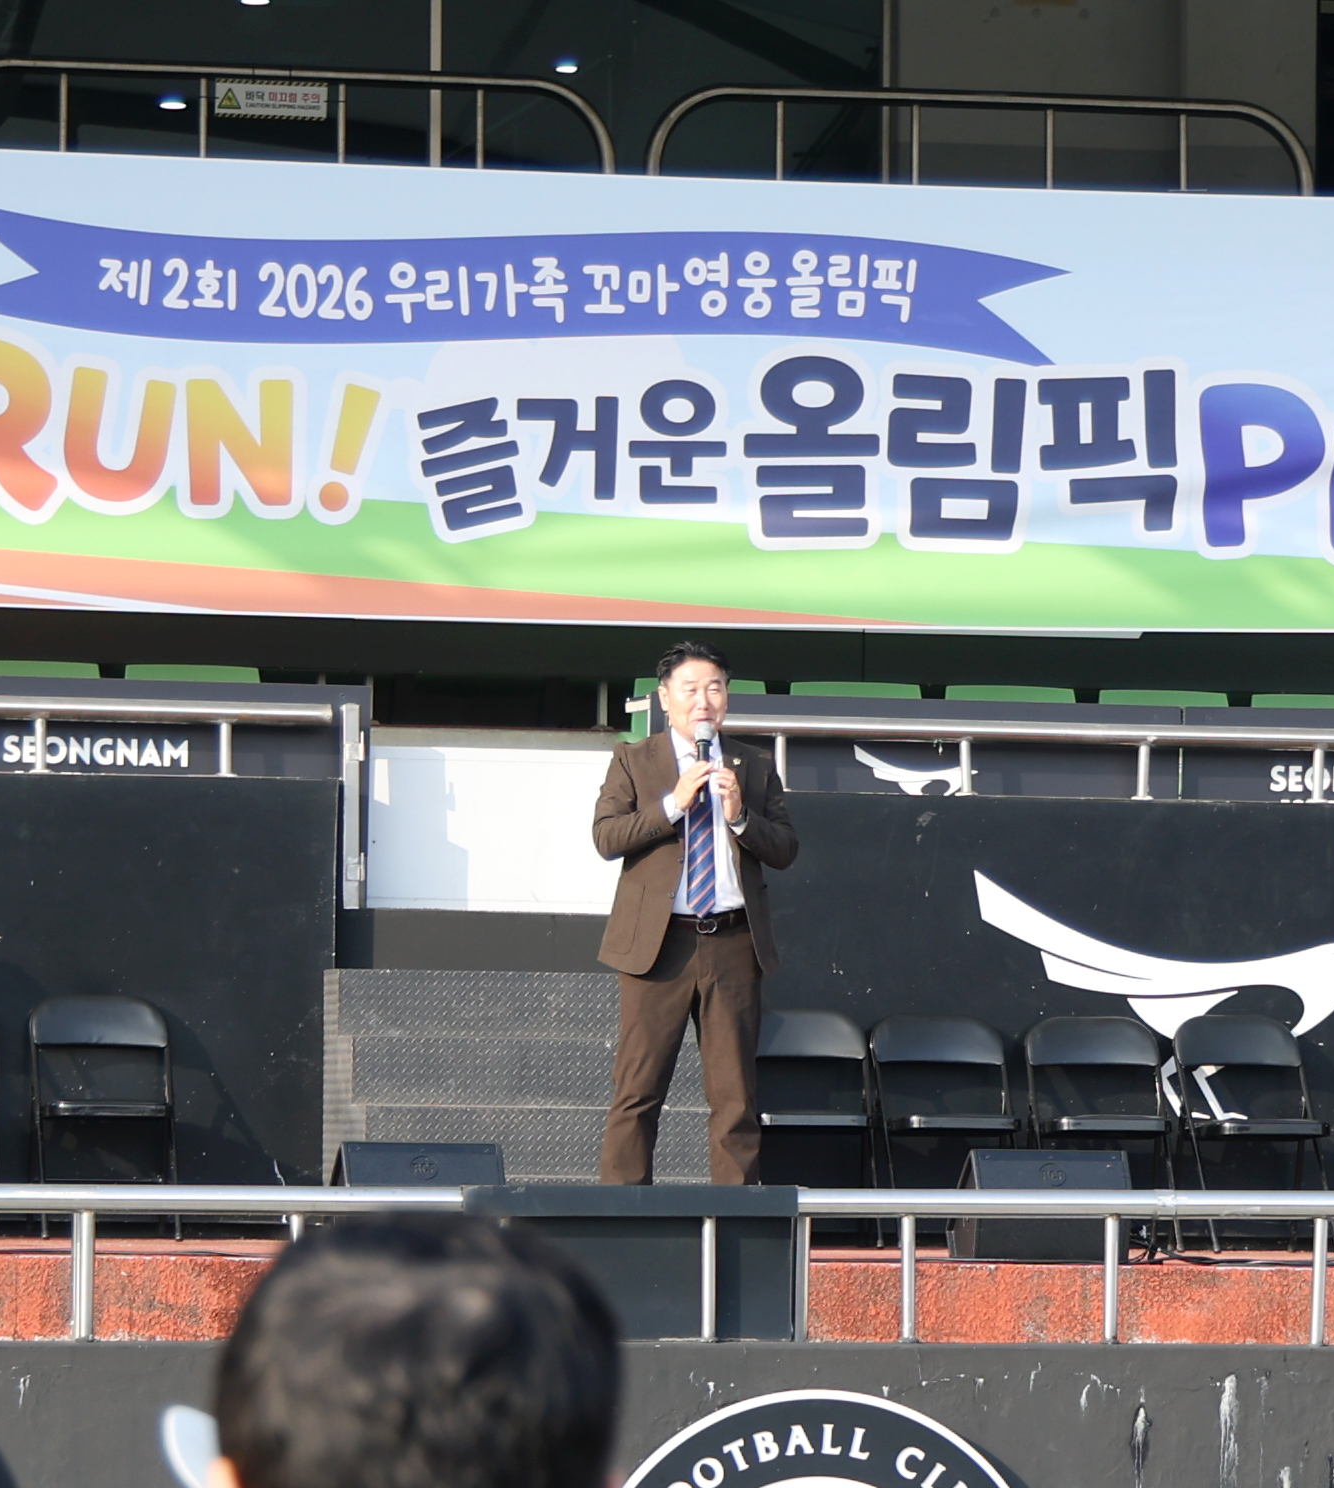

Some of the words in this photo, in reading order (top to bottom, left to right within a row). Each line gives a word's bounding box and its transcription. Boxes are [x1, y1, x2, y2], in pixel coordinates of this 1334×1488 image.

[258, 261, 374, 321] 2026
[385, 256, 569, 324] 우리가족
[417, 379, 727, 532] 즐거운
[743, 354, 1178, 541] 올림픽
[2, 735, 189, 768] SEONGNAM
